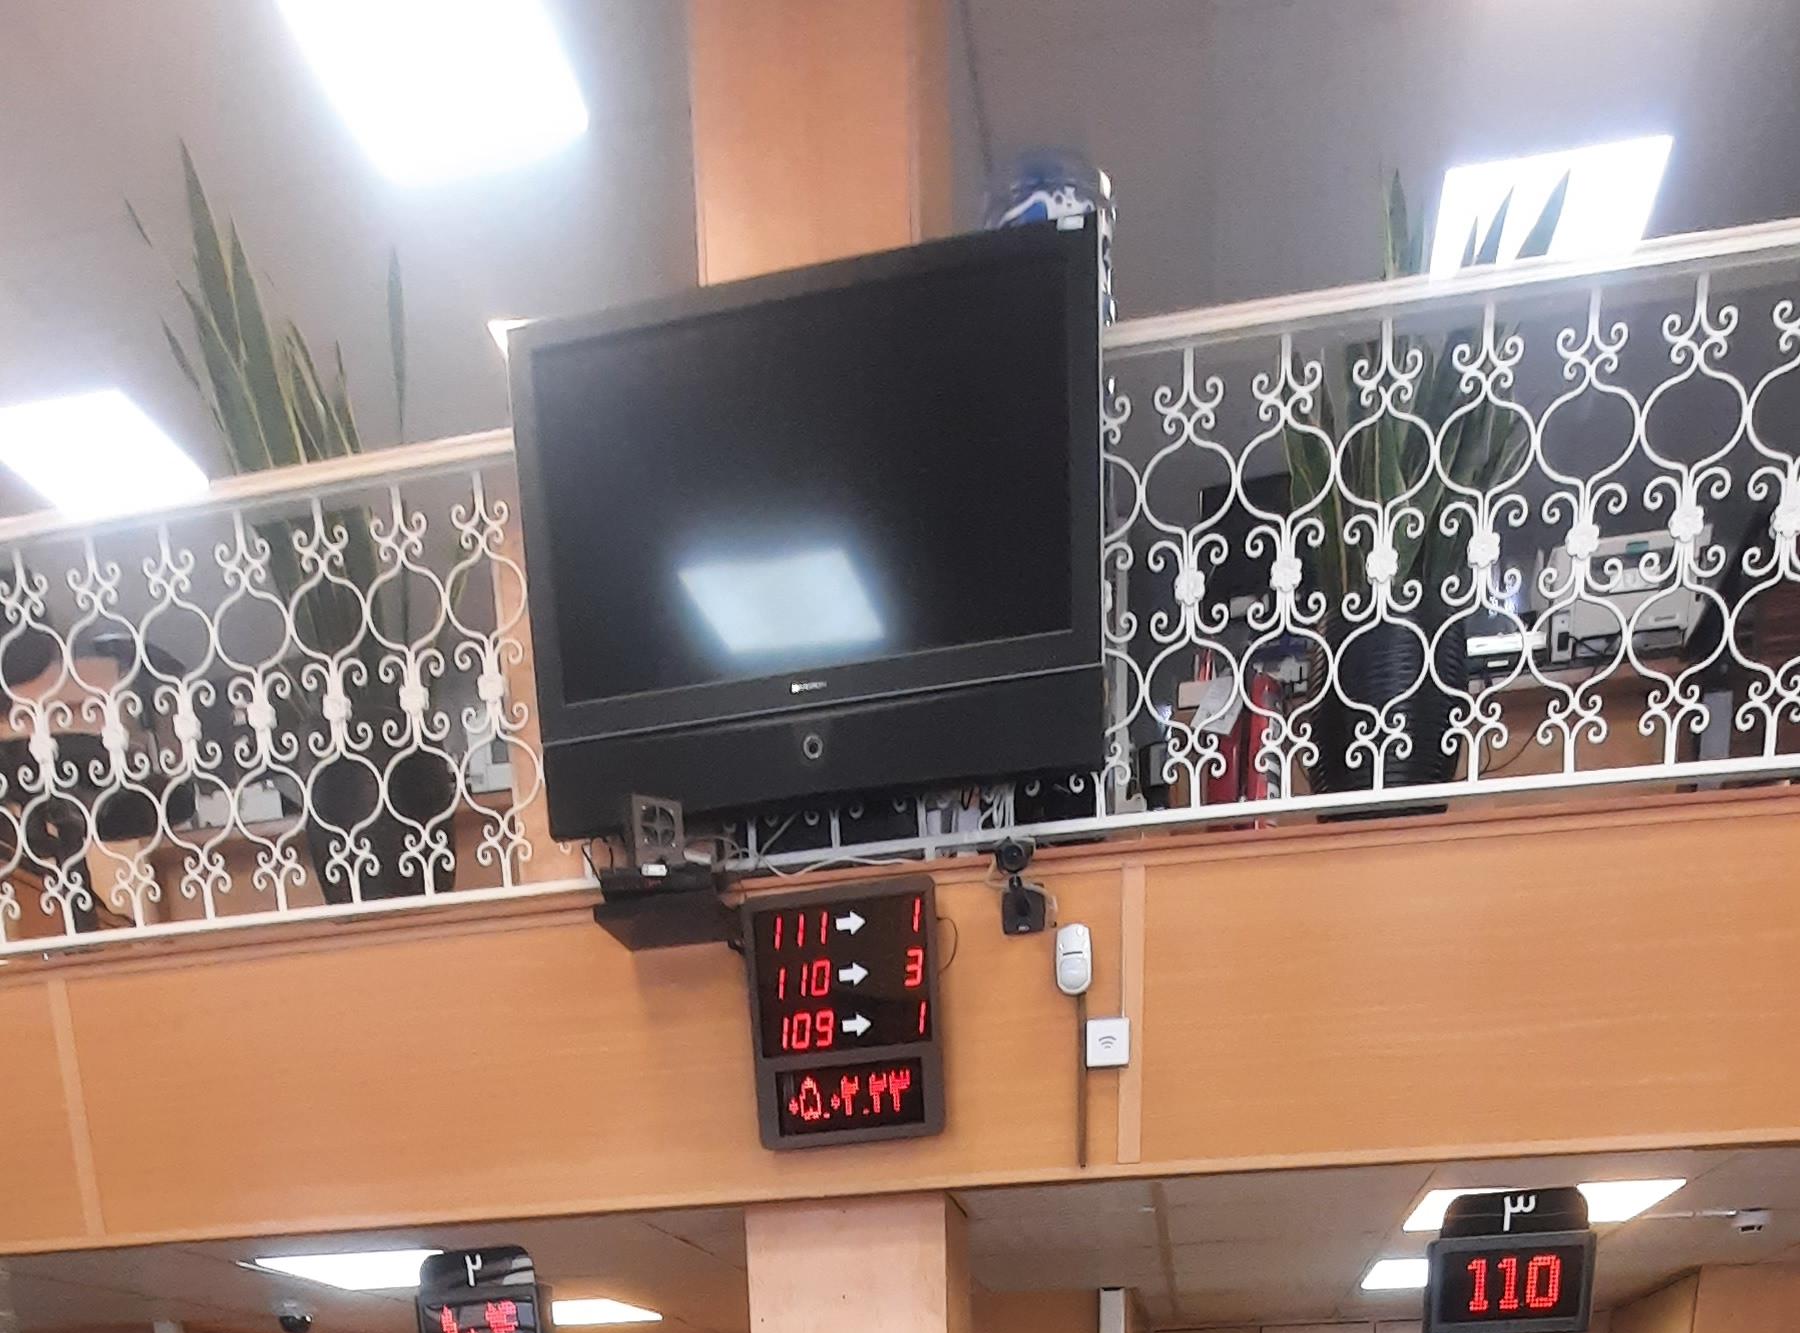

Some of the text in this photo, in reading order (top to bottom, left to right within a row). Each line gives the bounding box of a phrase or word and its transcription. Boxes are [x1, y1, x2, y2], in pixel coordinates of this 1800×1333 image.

[774, 896, 922, 950] 111 1
[778, 946, 924, 1000] 110 3
[782, 1001, 927, 1050] 109 1
[1502, 1194, 1537, 1232] ۳
[465, 1253, 484, 1287] ۲
[1467, 1254, 1561, 1312] 110
